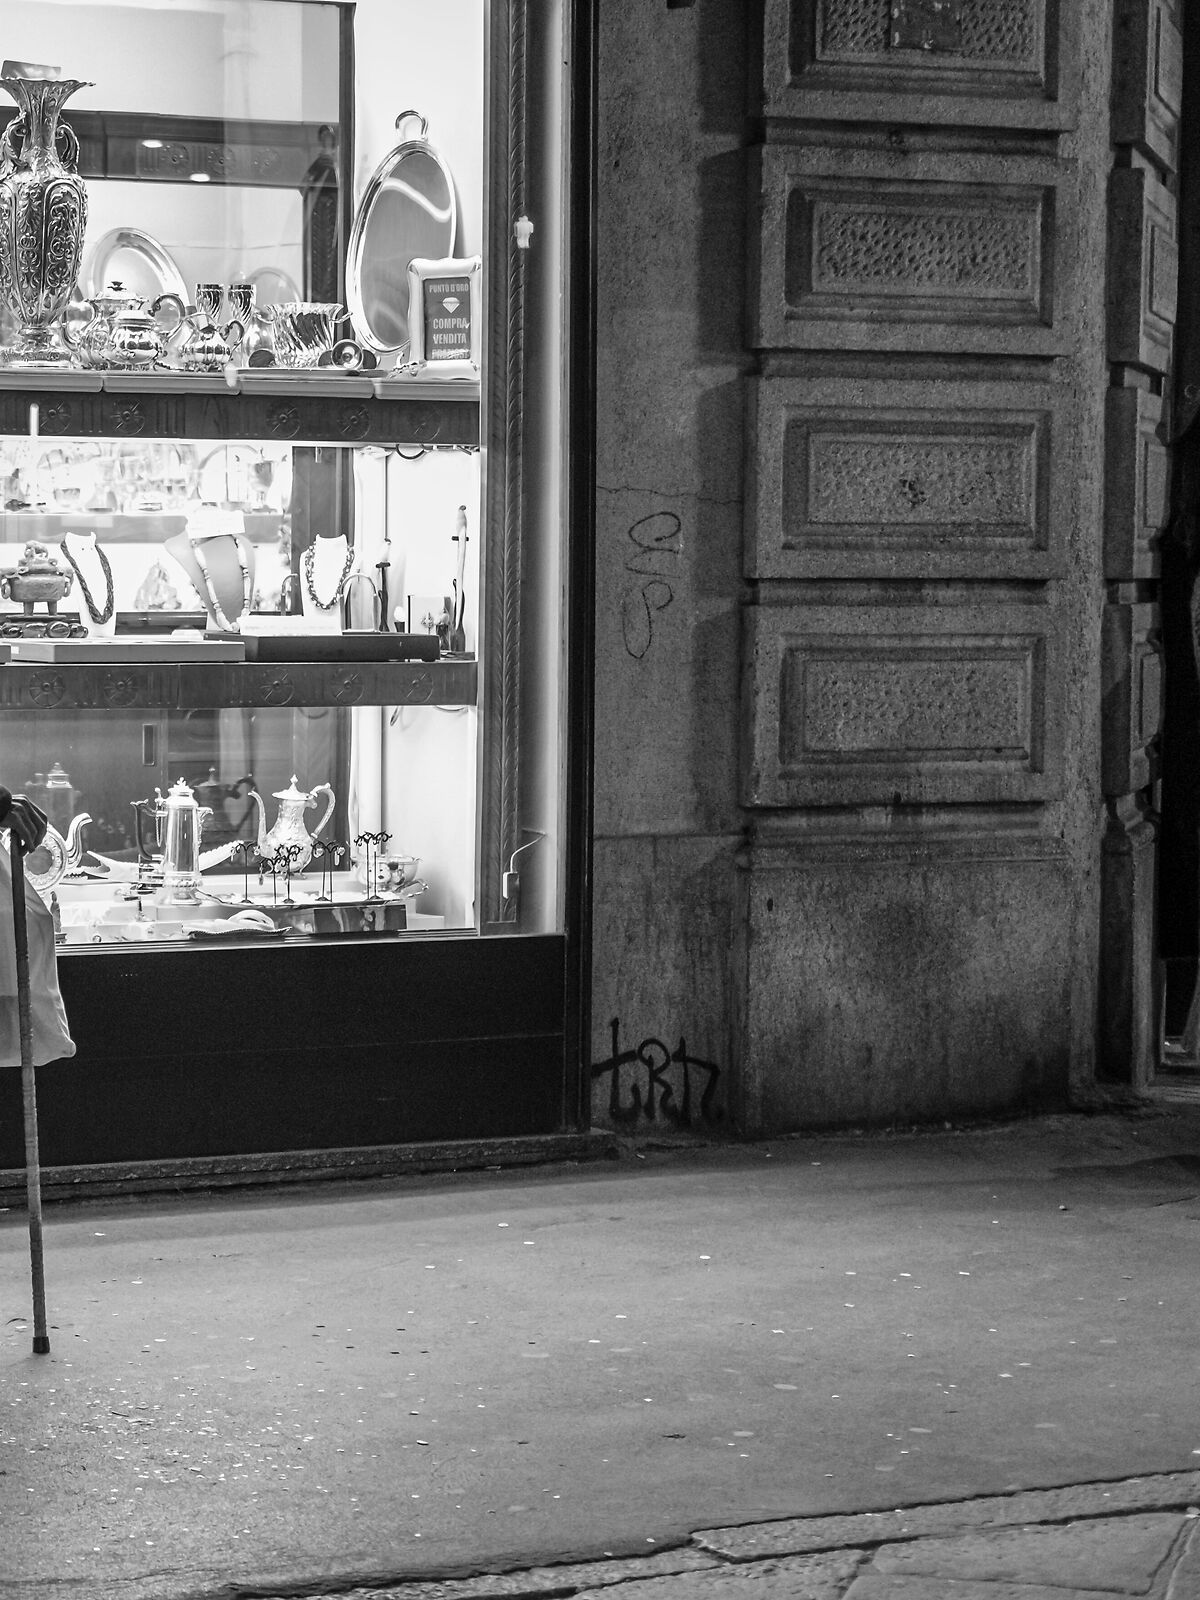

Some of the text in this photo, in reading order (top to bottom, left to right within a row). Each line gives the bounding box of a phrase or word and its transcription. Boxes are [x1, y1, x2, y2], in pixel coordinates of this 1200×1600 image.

[429, 284, 450, 293] PUNTO
[433, 318, 468, 329] COMPRA
[433, 333, 467, 344] VENDITA
